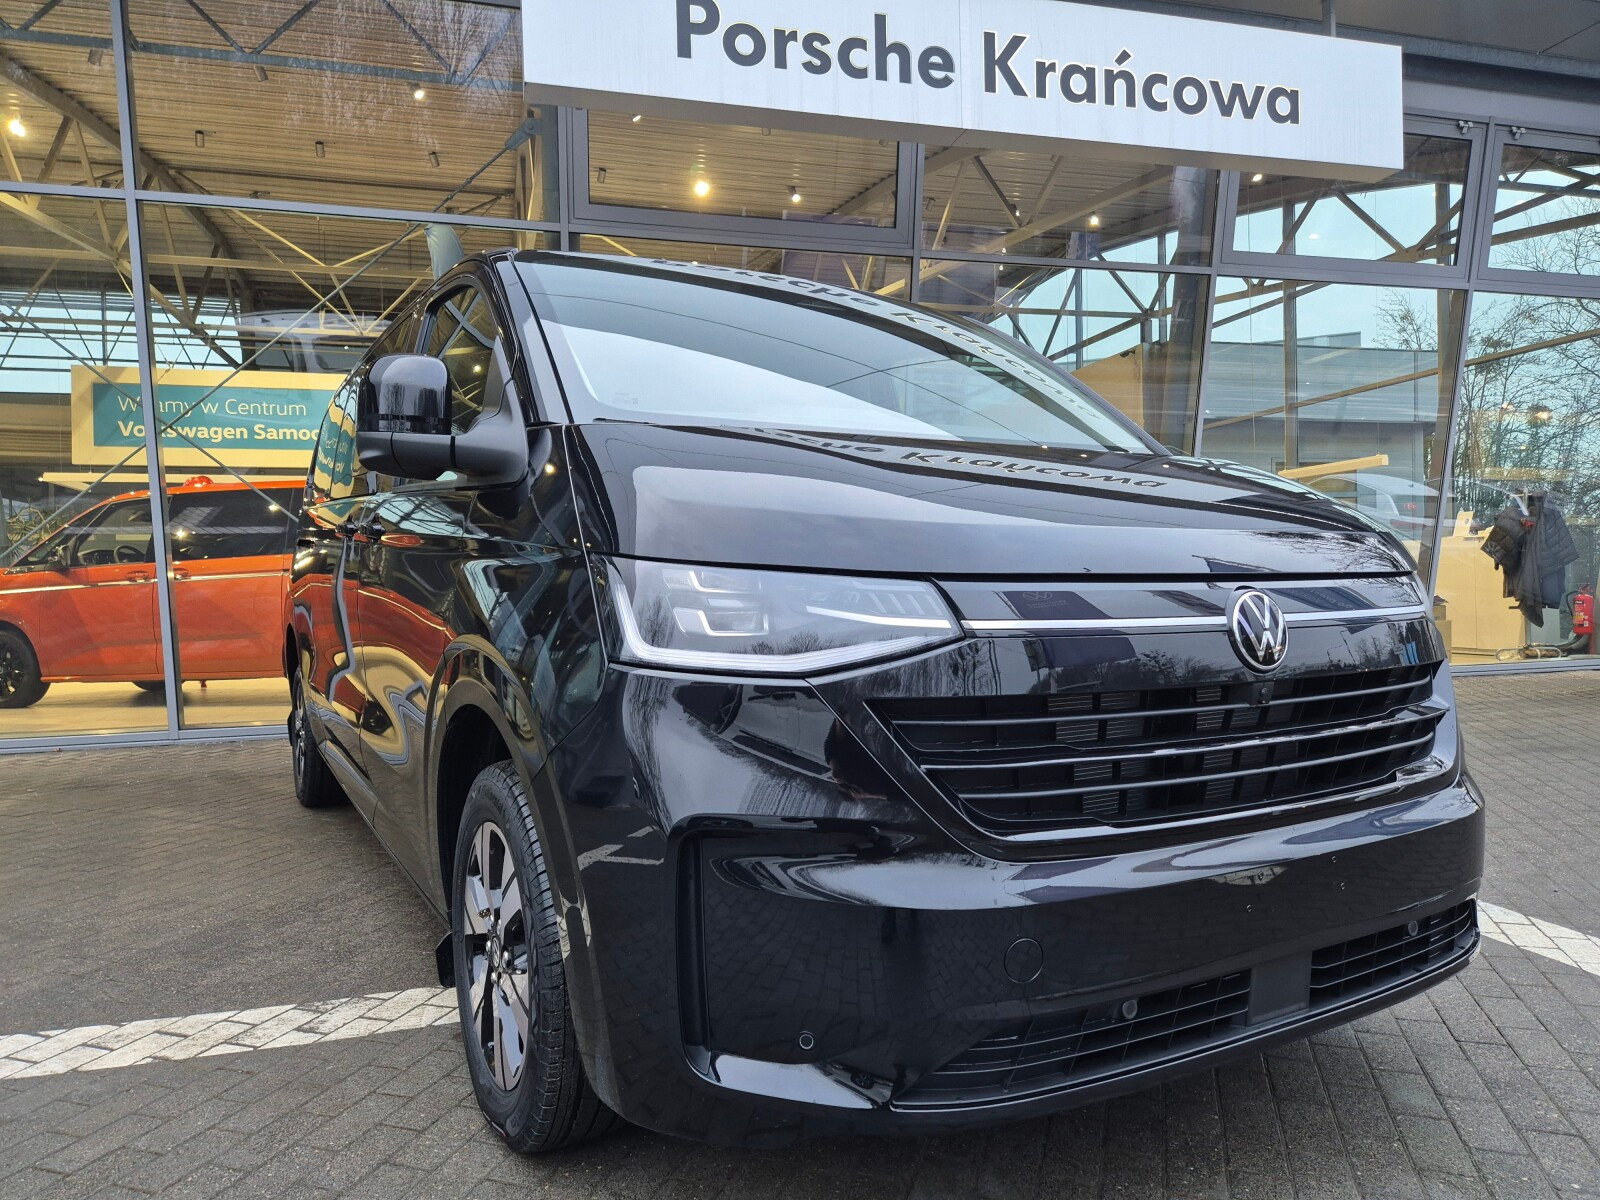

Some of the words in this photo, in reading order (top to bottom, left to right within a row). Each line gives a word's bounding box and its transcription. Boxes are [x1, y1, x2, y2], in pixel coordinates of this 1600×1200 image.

[676, 0, 956, 89] Porsche
[983, 31, 1302, 126] Krańcowa
[201, 402, 219, 414] w
[225, 399, 307, 416] Centrum
[117, 421, 248, 443] Voswagen
